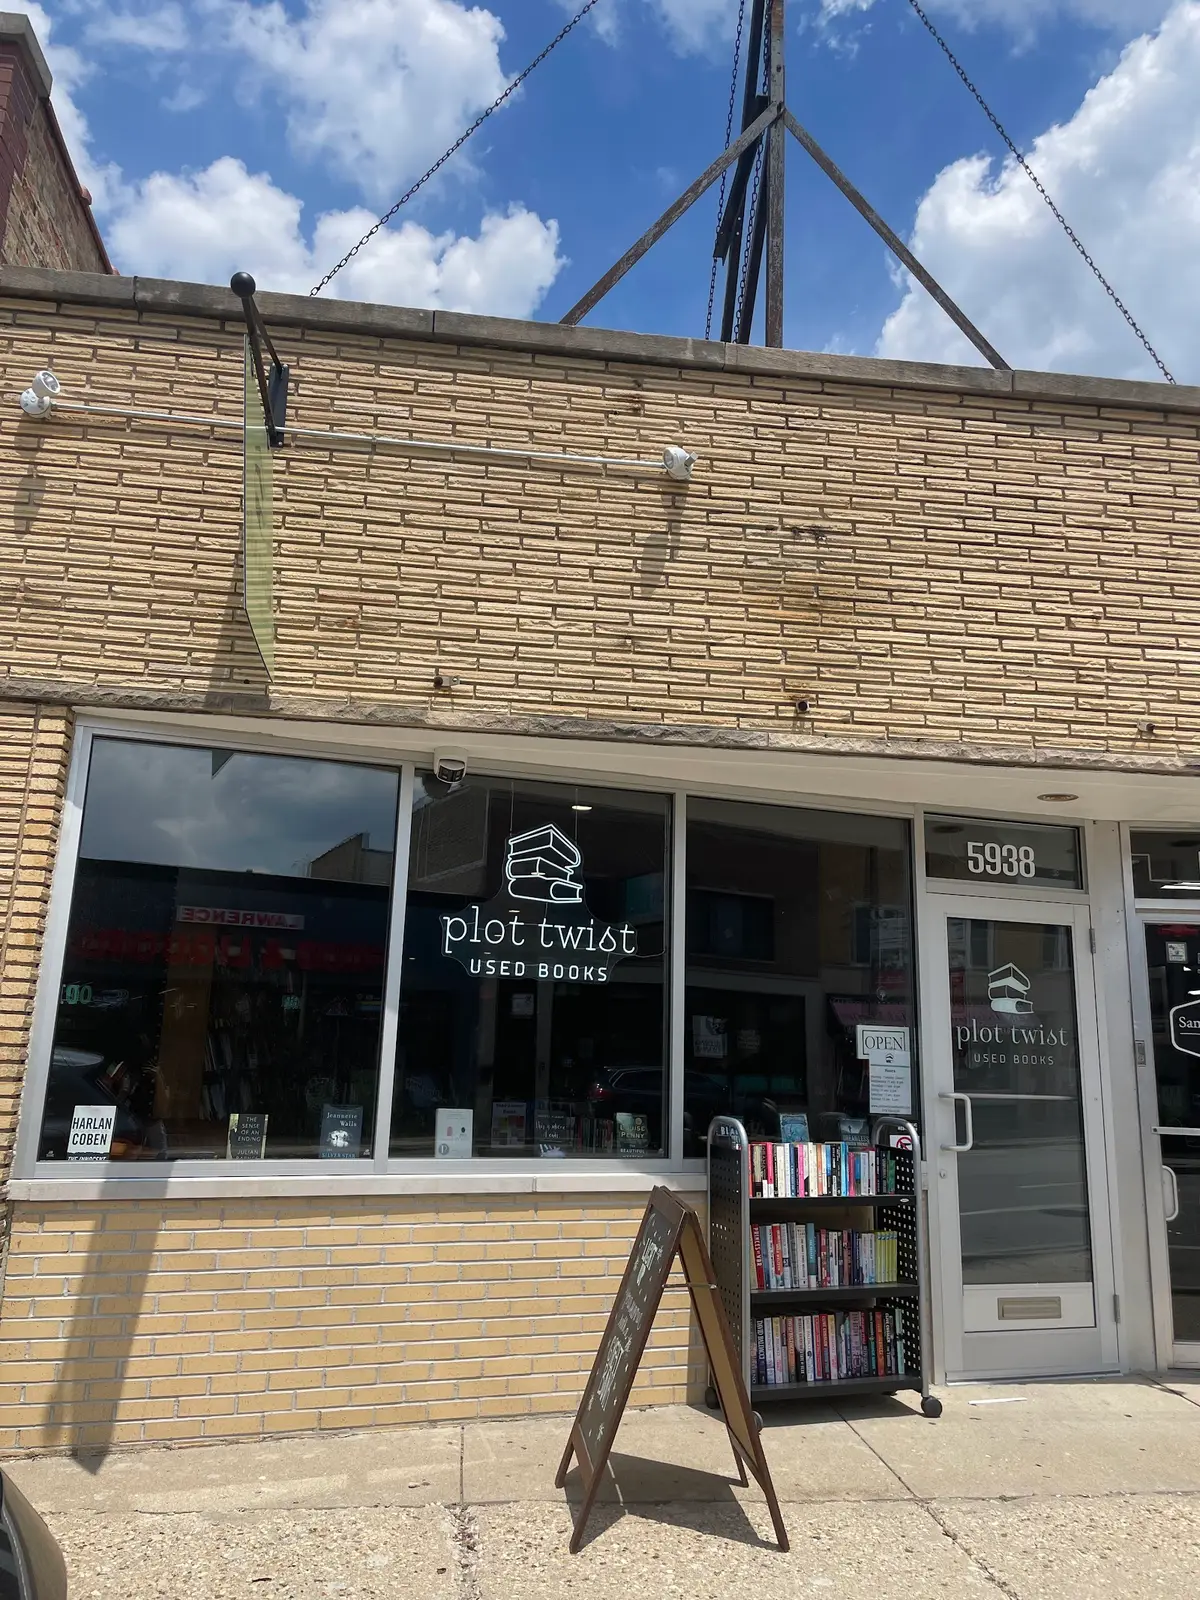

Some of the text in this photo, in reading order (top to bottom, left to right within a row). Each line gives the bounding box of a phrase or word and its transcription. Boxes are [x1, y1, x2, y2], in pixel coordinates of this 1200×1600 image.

[967, 841, 1036, 878] 5938
[443, 905, 636, 954] plot twist
[470, 958, 608, 982] USED BOOKS
[864, 1035, 903, 1051] OPEN
[956, 1018, 1069, 1050] plot twist
[974, 1053, 1055, 1066] USED BOOKS
[72, 1117, 113, 1130] HARLAN
[72, 1133, 108, 1146] COBEN
